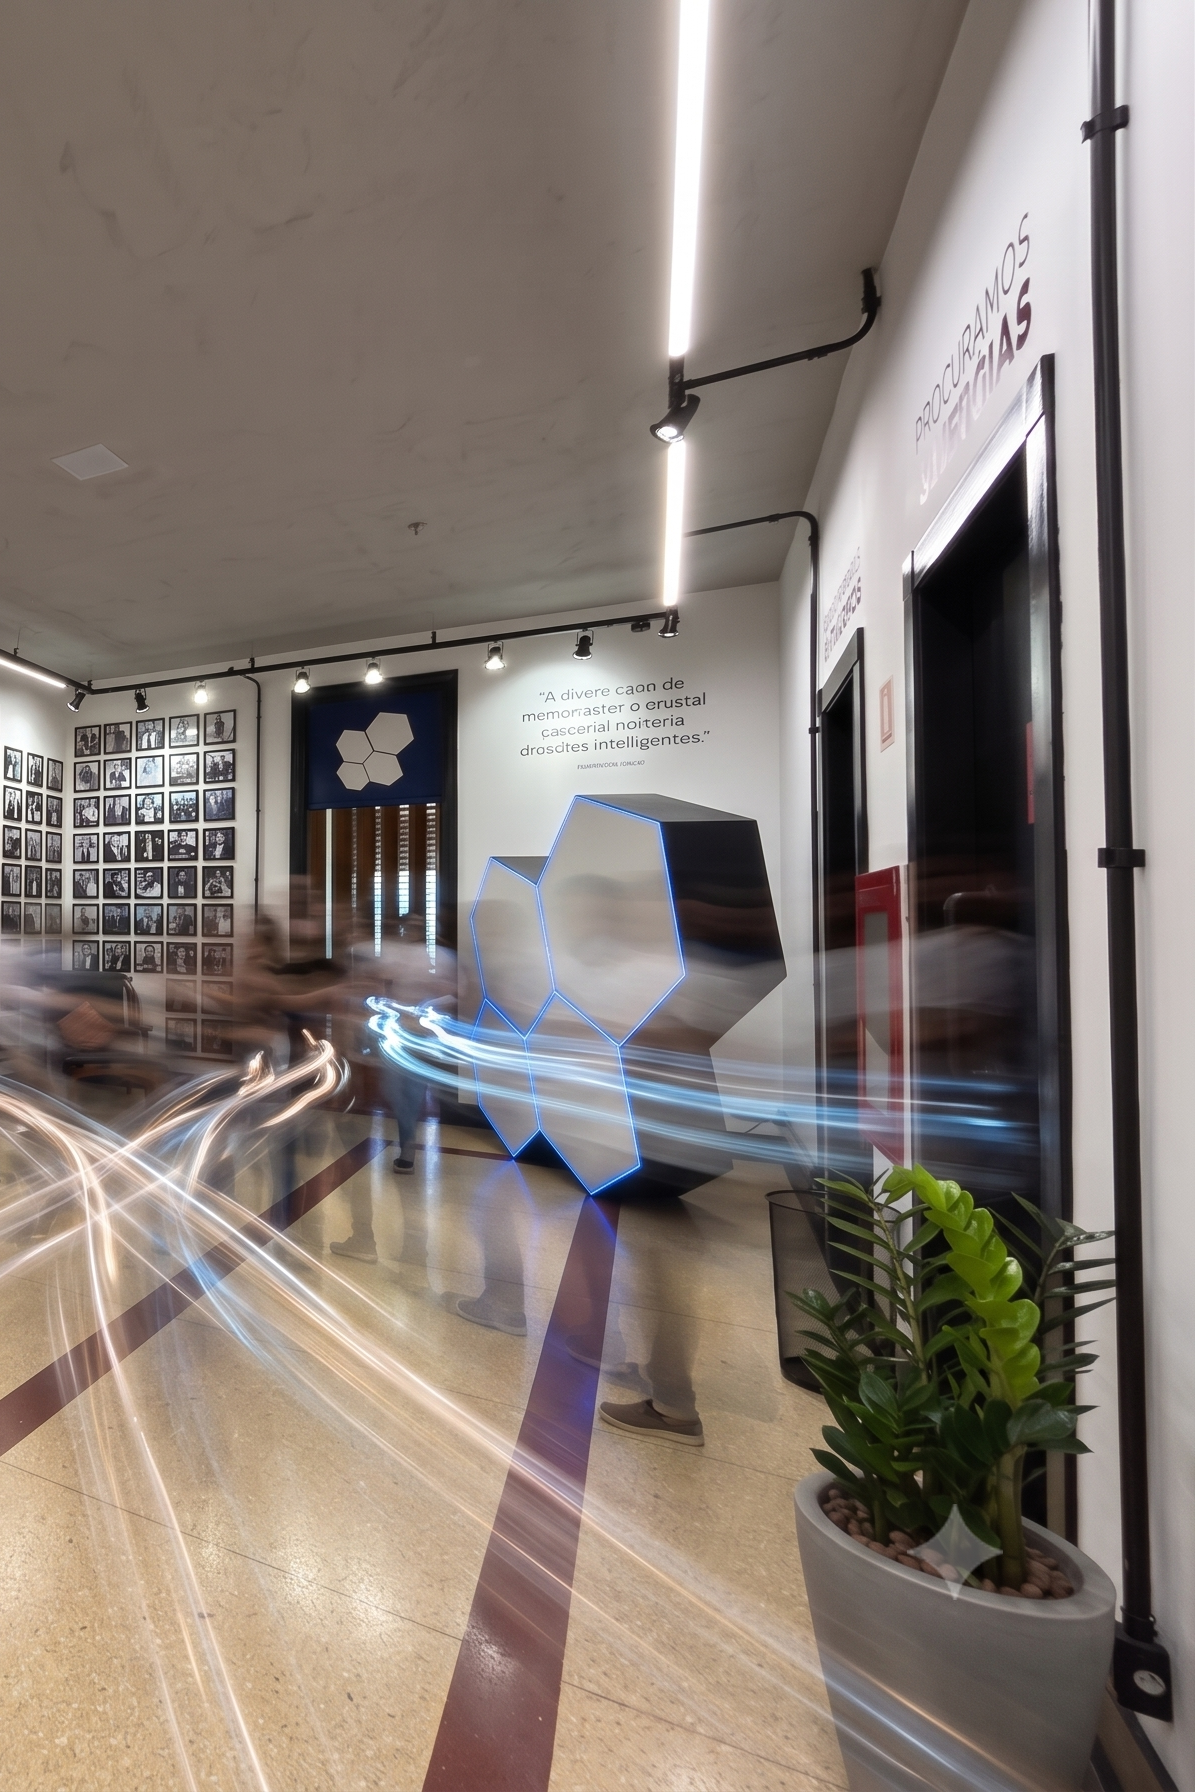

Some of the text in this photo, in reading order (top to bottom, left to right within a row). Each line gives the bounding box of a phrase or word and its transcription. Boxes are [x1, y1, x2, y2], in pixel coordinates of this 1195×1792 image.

[915, 211, 1031, 455] PROCURAMOS
[560, 688, 610, 701] divere
[662, 677, 685, 691] de
[630, 702, 641, 712] o
